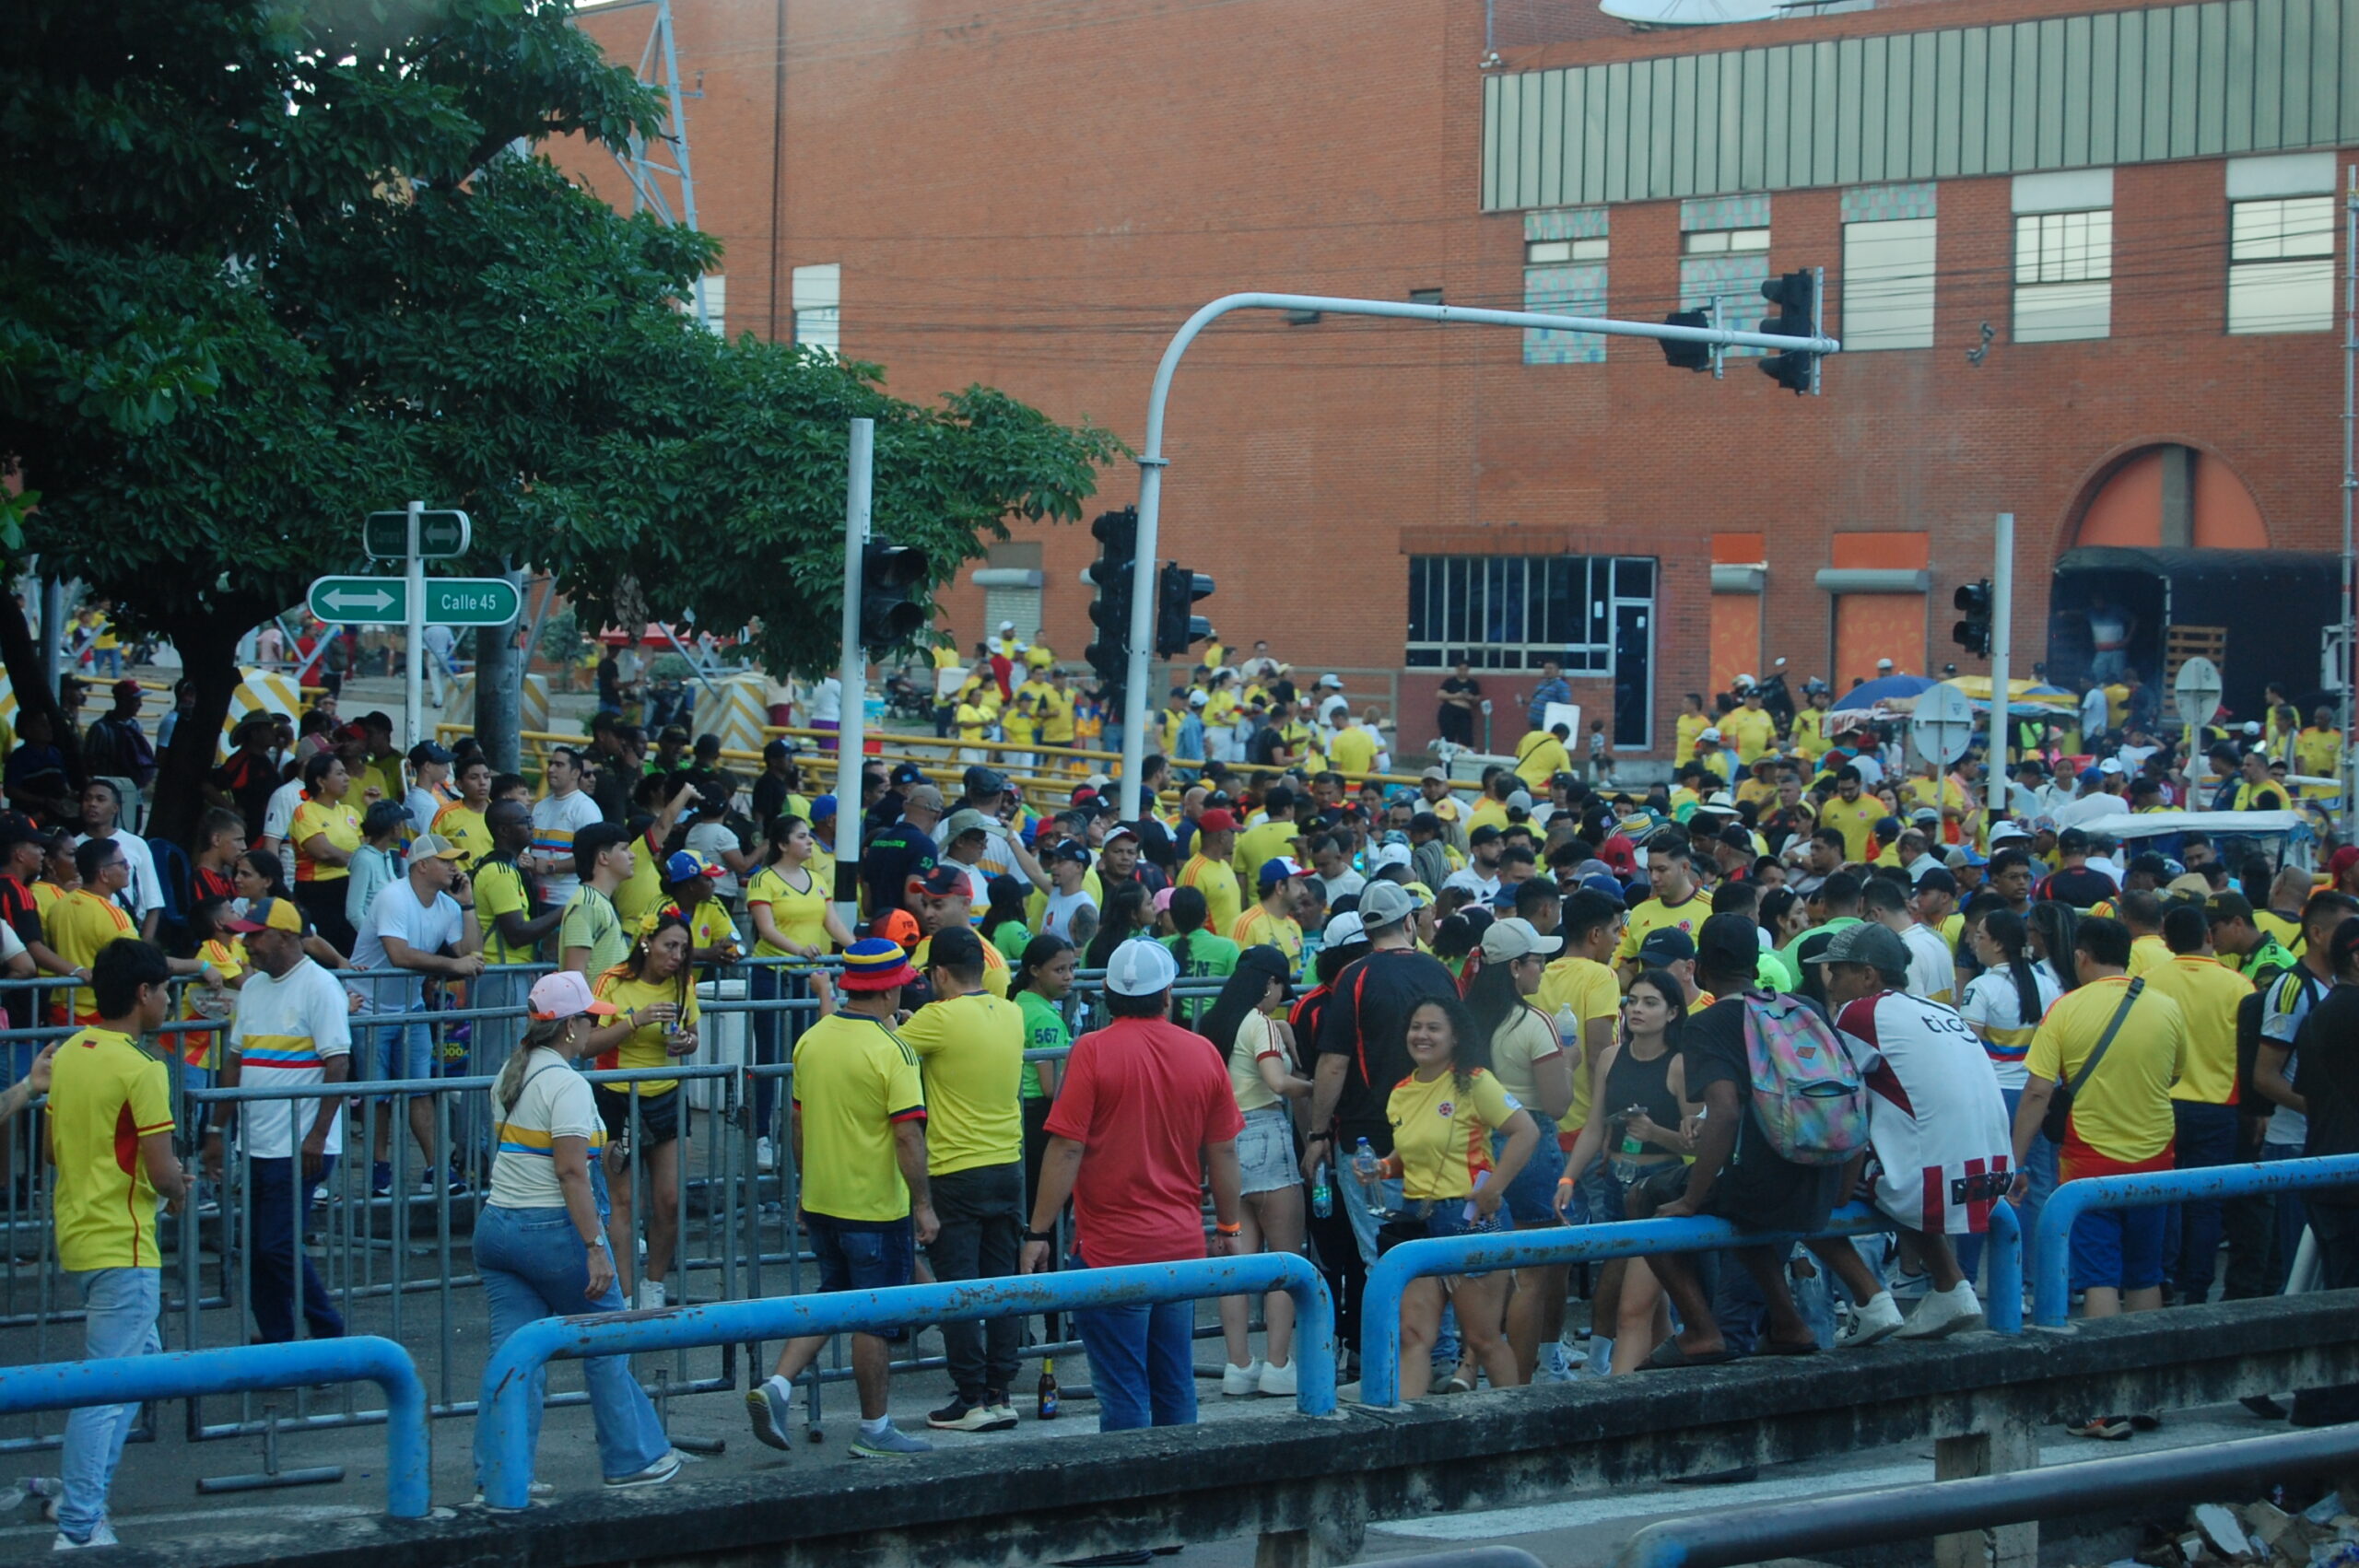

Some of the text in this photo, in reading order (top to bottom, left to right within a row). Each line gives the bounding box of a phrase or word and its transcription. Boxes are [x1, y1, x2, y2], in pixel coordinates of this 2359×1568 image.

[441, 593, 496, 610] Calle 45
[1035, 1027, 1059, 1044] 567
